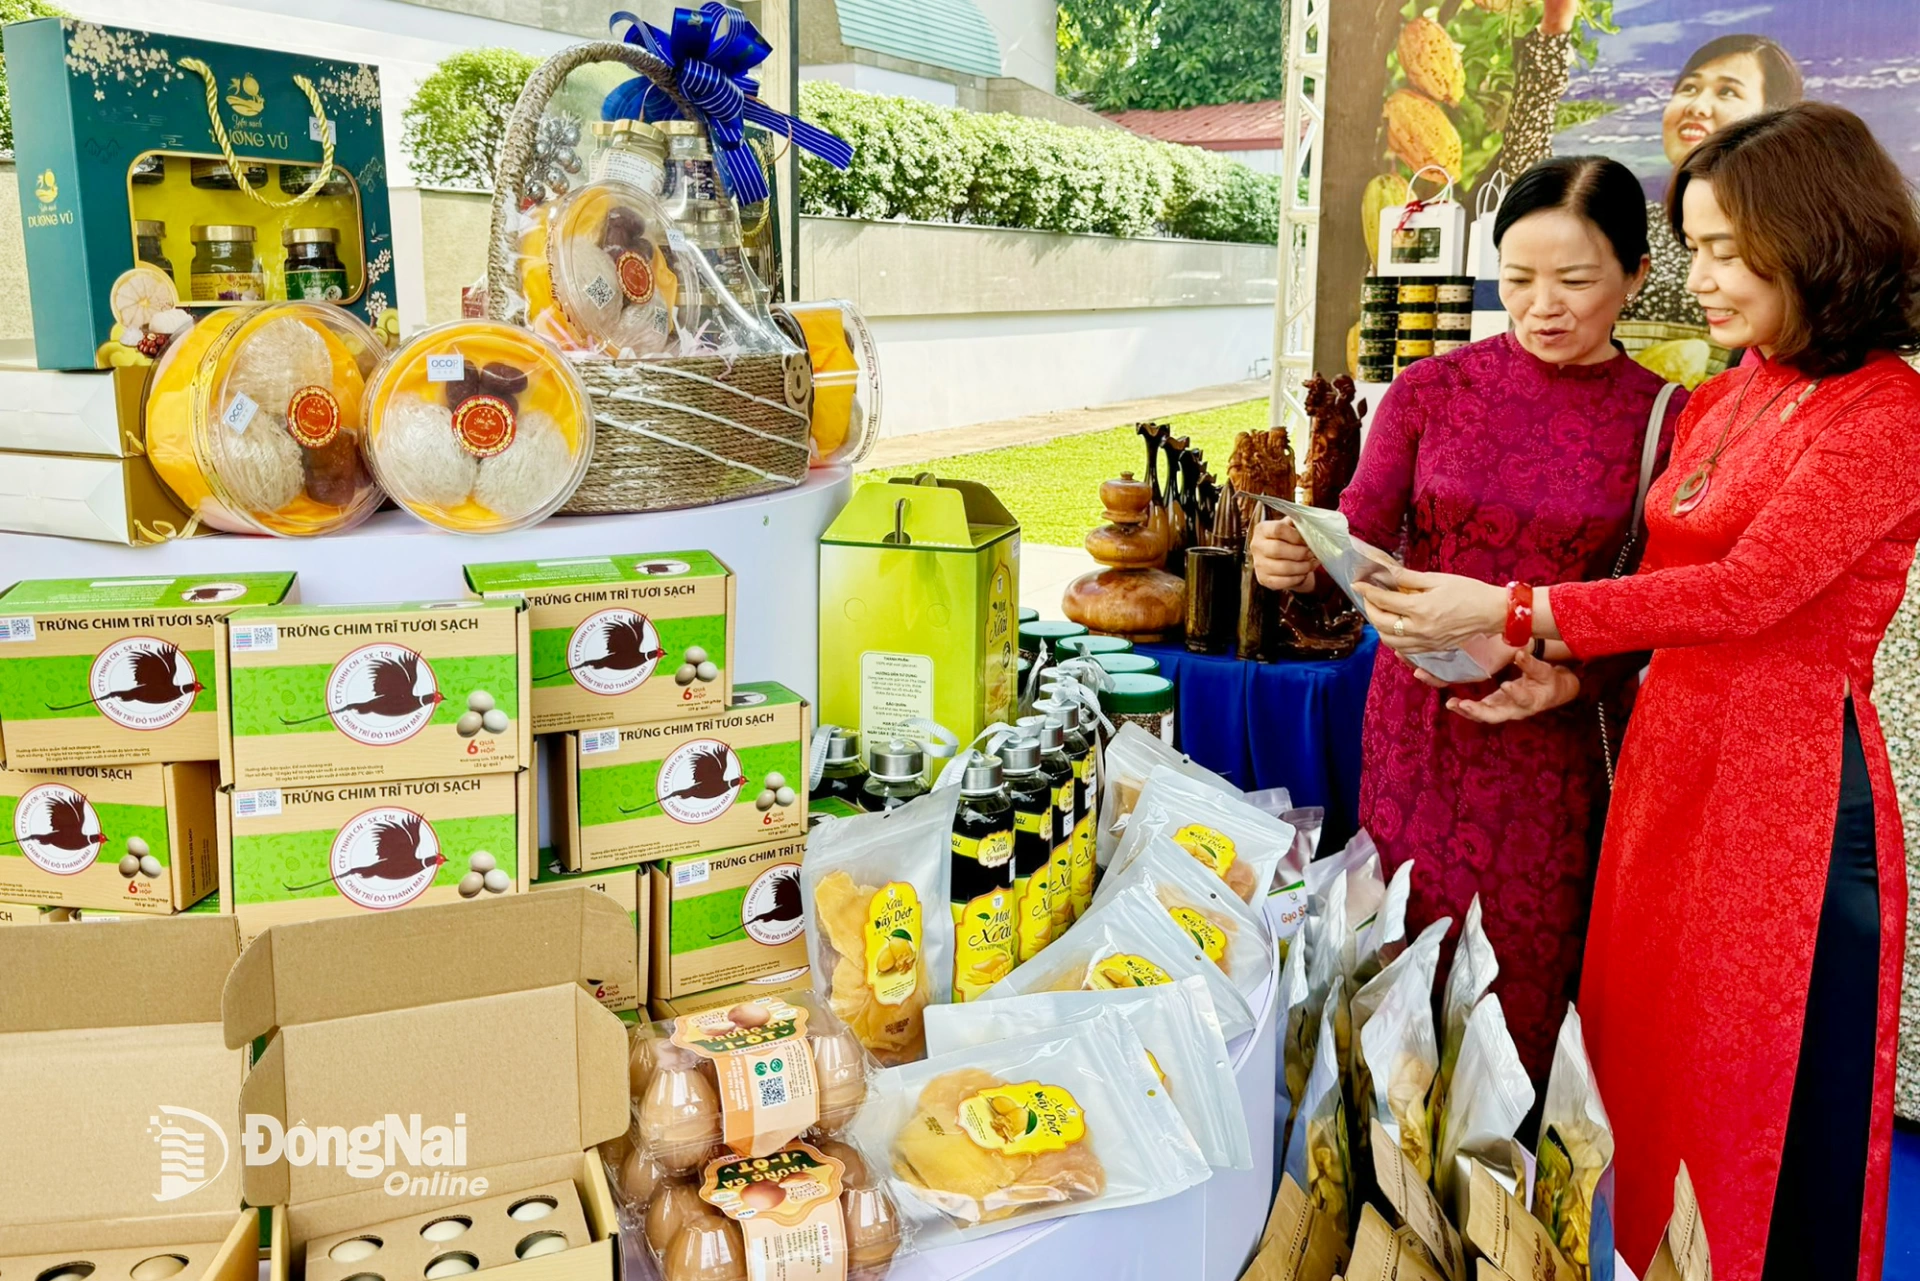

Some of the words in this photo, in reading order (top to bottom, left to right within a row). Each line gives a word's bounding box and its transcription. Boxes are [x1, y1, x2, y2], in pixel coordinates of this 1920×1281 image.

[267, 132, 288, 150] VŨ
[59, 210, 74, 224] VŨ
[431, 359, 459, 368] OCOP
[229, 398, 245, 423] OCOP
[528, 592, 571, 607] TRỨNG
[575, 590, 606, 602] CHIM
[610, 587, 628, 600] TRĨ
[632, 586, 660, 599] TƯƠI
[664, 584, 695, 598] SẠCH
[37, 618, 89, 632] TRỨNG
[92, 616, 130, 629] CHIM
[132, 614, 154, 627] TRĨ
[159, 614, 192, 627] TƯƠI
[278, 624, 330, 638] TRỨNG
[334, 623, 372, 636] CHIM
[375, 620, 398, 633] TRĨ
[401, 619, 437, 632] TƯƠI
[440, 618, 479, 633] SẠCH
[586, 622, 596, 632] CN
[110, 650, 120, 660] CN
[348, 659, 360, 669] CN
[579, 670, 593, 685] CHIM
[615, 676, 636, 689] THANH
[634, 665, 648, 678] MAI
[682, 687, 693, 700] 6
[106, 702, 122, 717] CHIM
[148, 709, 174, 724] THANH
[172, 700, 184, 712] MAI
[342, 714, 358, 732] CHIM
[386, 724, 411, 738] THANH
[410, 712, 423, 725] MAI
[620, 727, 661, 742] TRỨNG
[664, 724, 694, 737] CHIM
[696, 720, 713, 734] TRĨ
[716, 716, 743, 729] TƯƠI
[746, 713, 774, 727] SẠCH
[466, 739, 479, 755] 6
[101, 768, 132, 782] SẠCH
[30, 796, 40, 804] CN
[283, 790, 335, 805] TRỨNG
[338, 787, 376, 802] CHIM
[380, 783, 402, 798] TRĨ
[404, 782, 440, 796] TƯƠI
[443, 779, 481, 796] SẠCH
[763, 812, 772, 825] 6
[352, 823, 365, 834] CN
[26, 844, 40, 859] CHIM
[62, 858, 82, 869] THANH
[80, 848, 92, 861] MAI
[709, 856, 747, 871] TRỨNG
[748, 850, 776, 863] CHIM
[128, 880, 138, 894] 6
[345, 880, 361, 896] CHIM
[388, 888, 414, 901] THANH
[413, 874, 426, 888] MAI
[968, 924, 1012, 947] Xoài
[596, 986, 606, 998] 6
